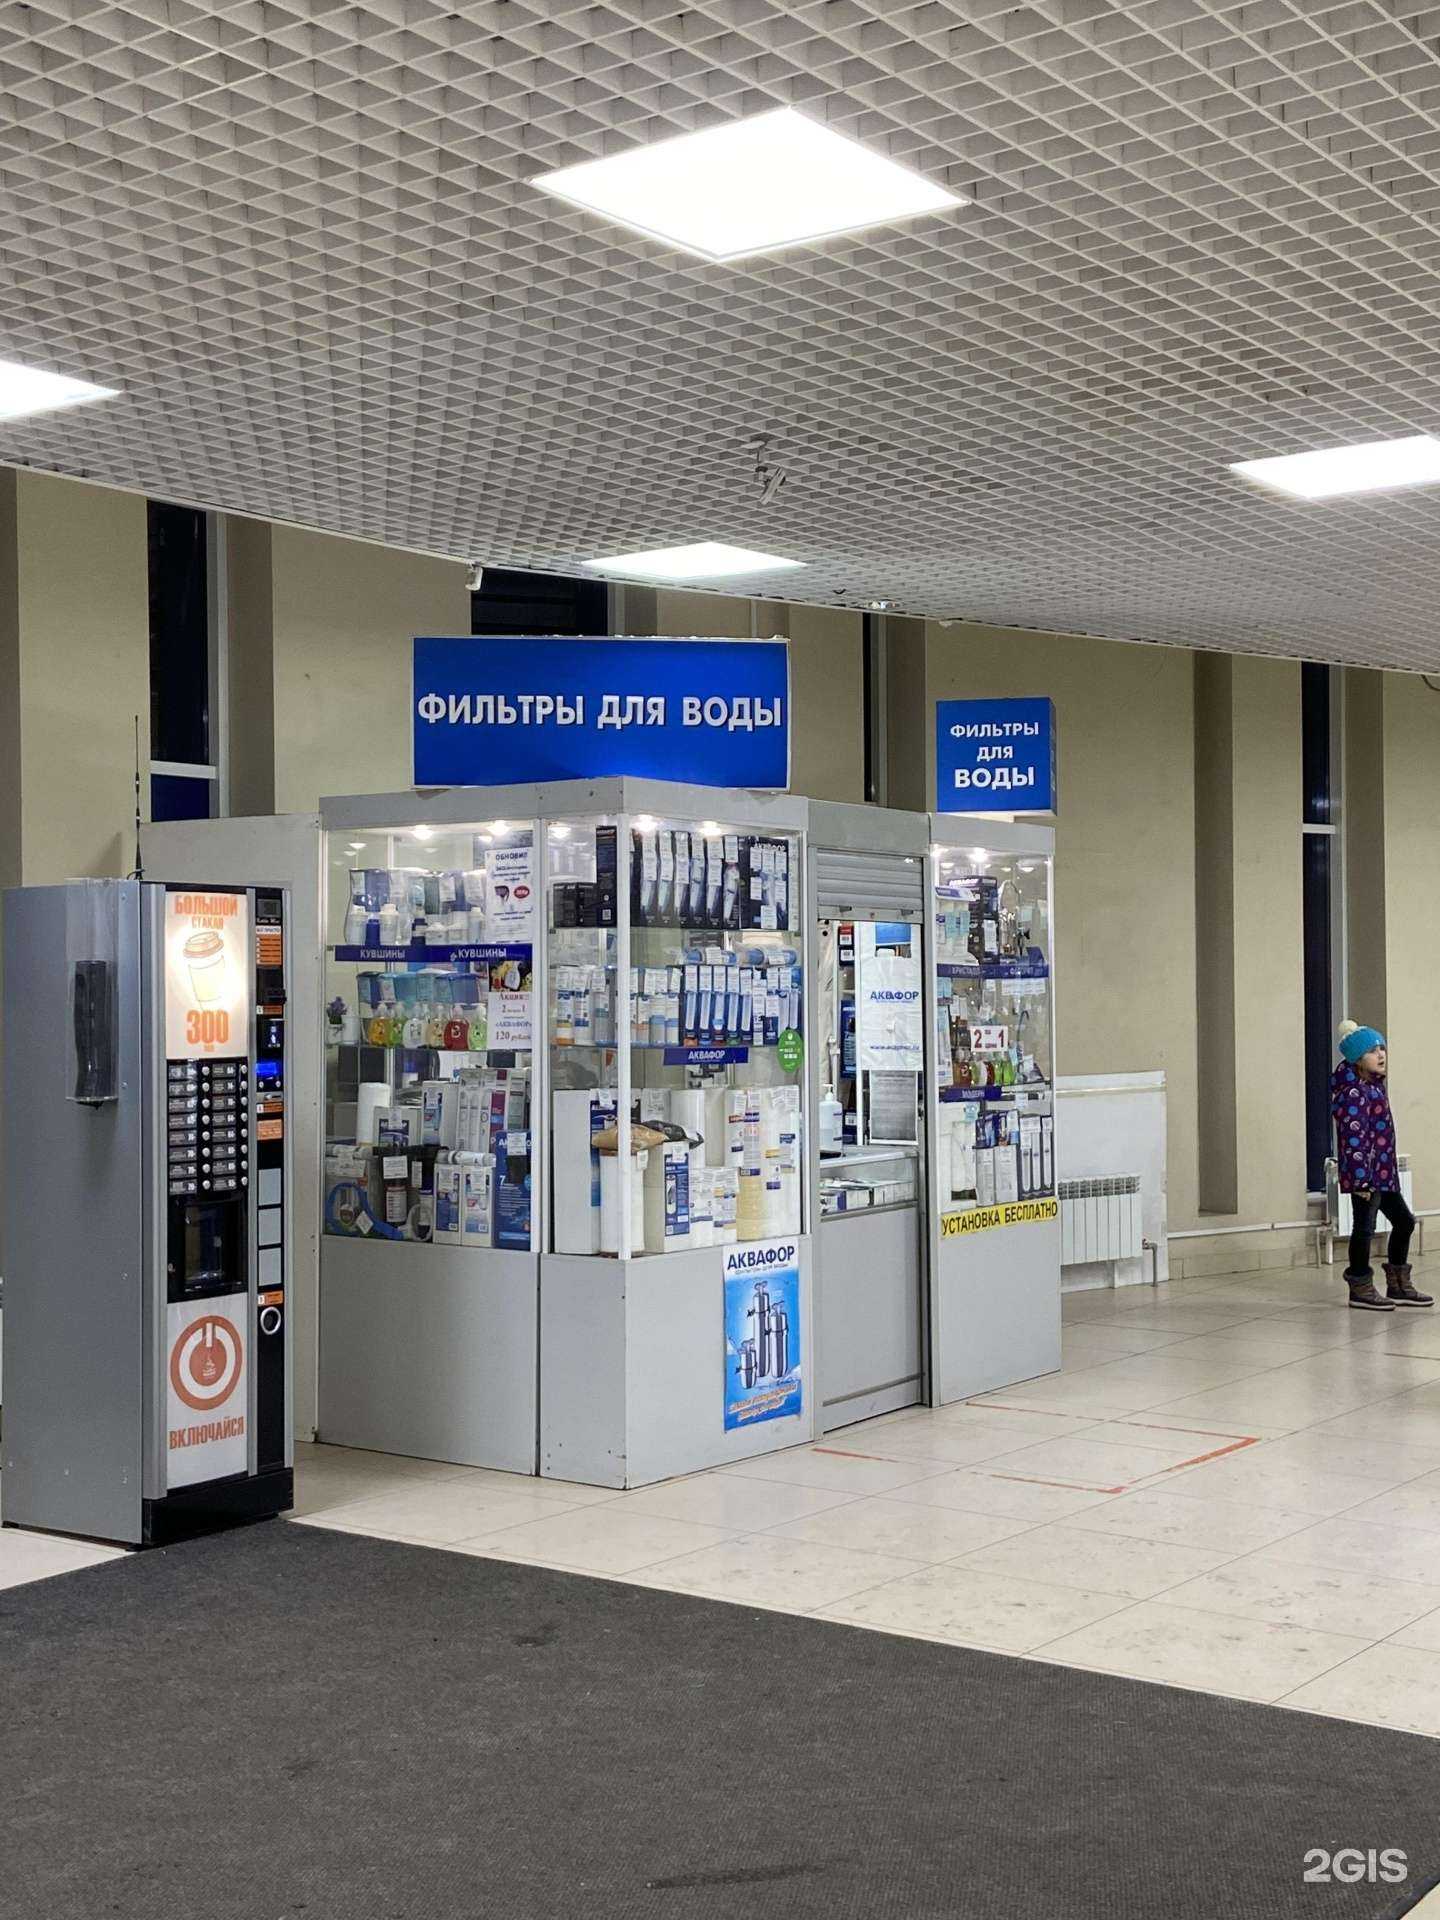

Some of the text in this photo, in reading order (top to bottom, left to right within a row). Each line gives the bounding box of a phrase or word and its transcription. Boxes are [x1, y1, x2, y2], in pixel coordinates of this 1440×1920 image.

[417, 692, 782, 732] ФИЛЬТРЫ ДЛЯ ВОДЫ
[950, 722, 1039, 738] ФИЛЬТРЫ
[976, 745, 1013, 762] ДЛЯ
[954, 766, 1035, 790] ВОДЫ
[174, 895, 238, 916] БОЛЬШОЙ
[360, 949, 406, 959] КУВШИНЫ
[458, 948, 507, 959] КУВШИНЫ
[870, 990, 919, 1001] АКВАФОР
[186, 1009, 229, 1044] 300
[974, 1029, 982, 1048] 2
[998, 1028, 1005, 1048] 1
[688, 1050, 726, 1061] АКВАФОР
[942, 1201, 1058, 1236] УСТАНОВКА БЕСПЛАТНО
[727, 1245, 795, 1270] АКВАФОР
[169, 1416, 245, 1450] ВКЛЮЧАЙСЯ
